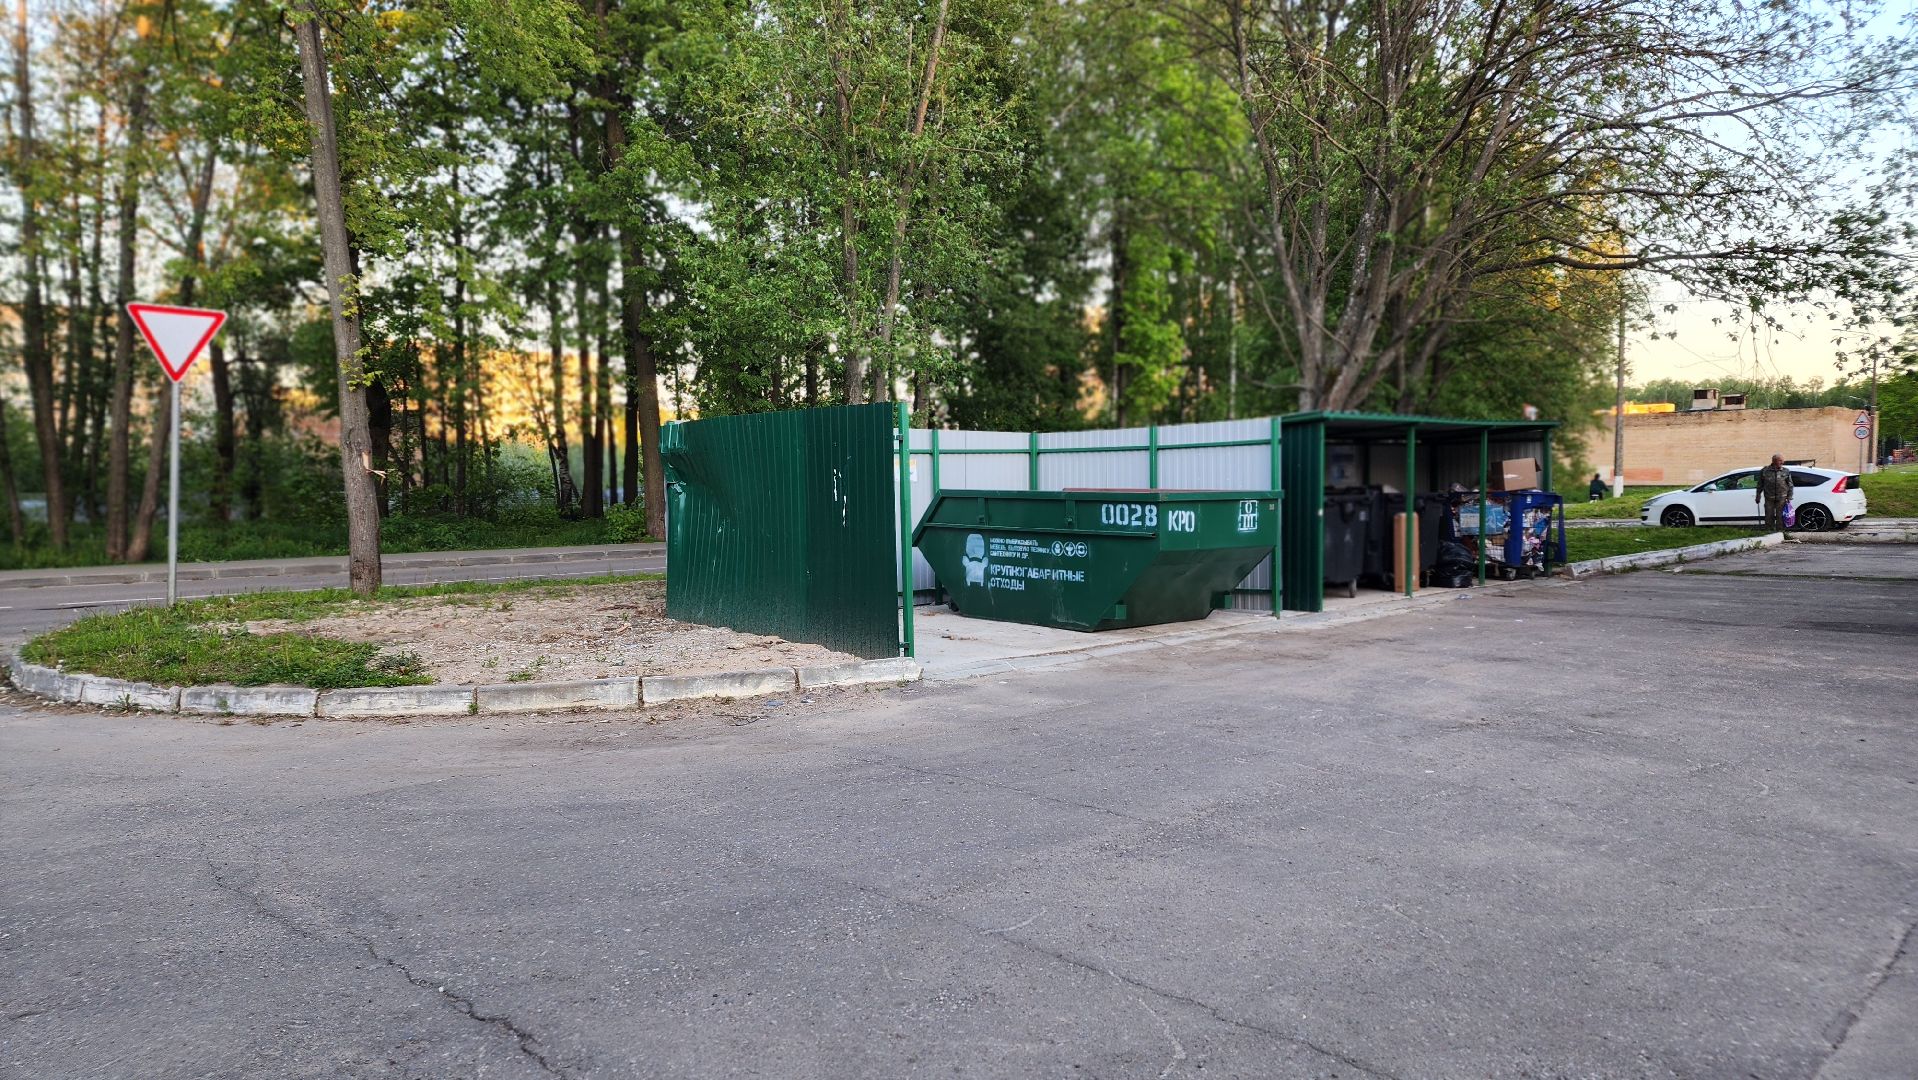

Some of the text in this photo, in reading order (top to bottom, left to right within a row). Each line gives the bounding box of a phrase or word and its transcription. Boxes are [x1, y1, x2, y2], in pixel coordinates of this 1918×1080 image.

[1101, 503, 1157, 527] 0028
[1168, 510, 1195, 533] КРО
[990, 564, 1085, 582] КРУПНОГАБАРИТНЫЕ
[990, 577, 1025, 591] ОТХОДЫ
